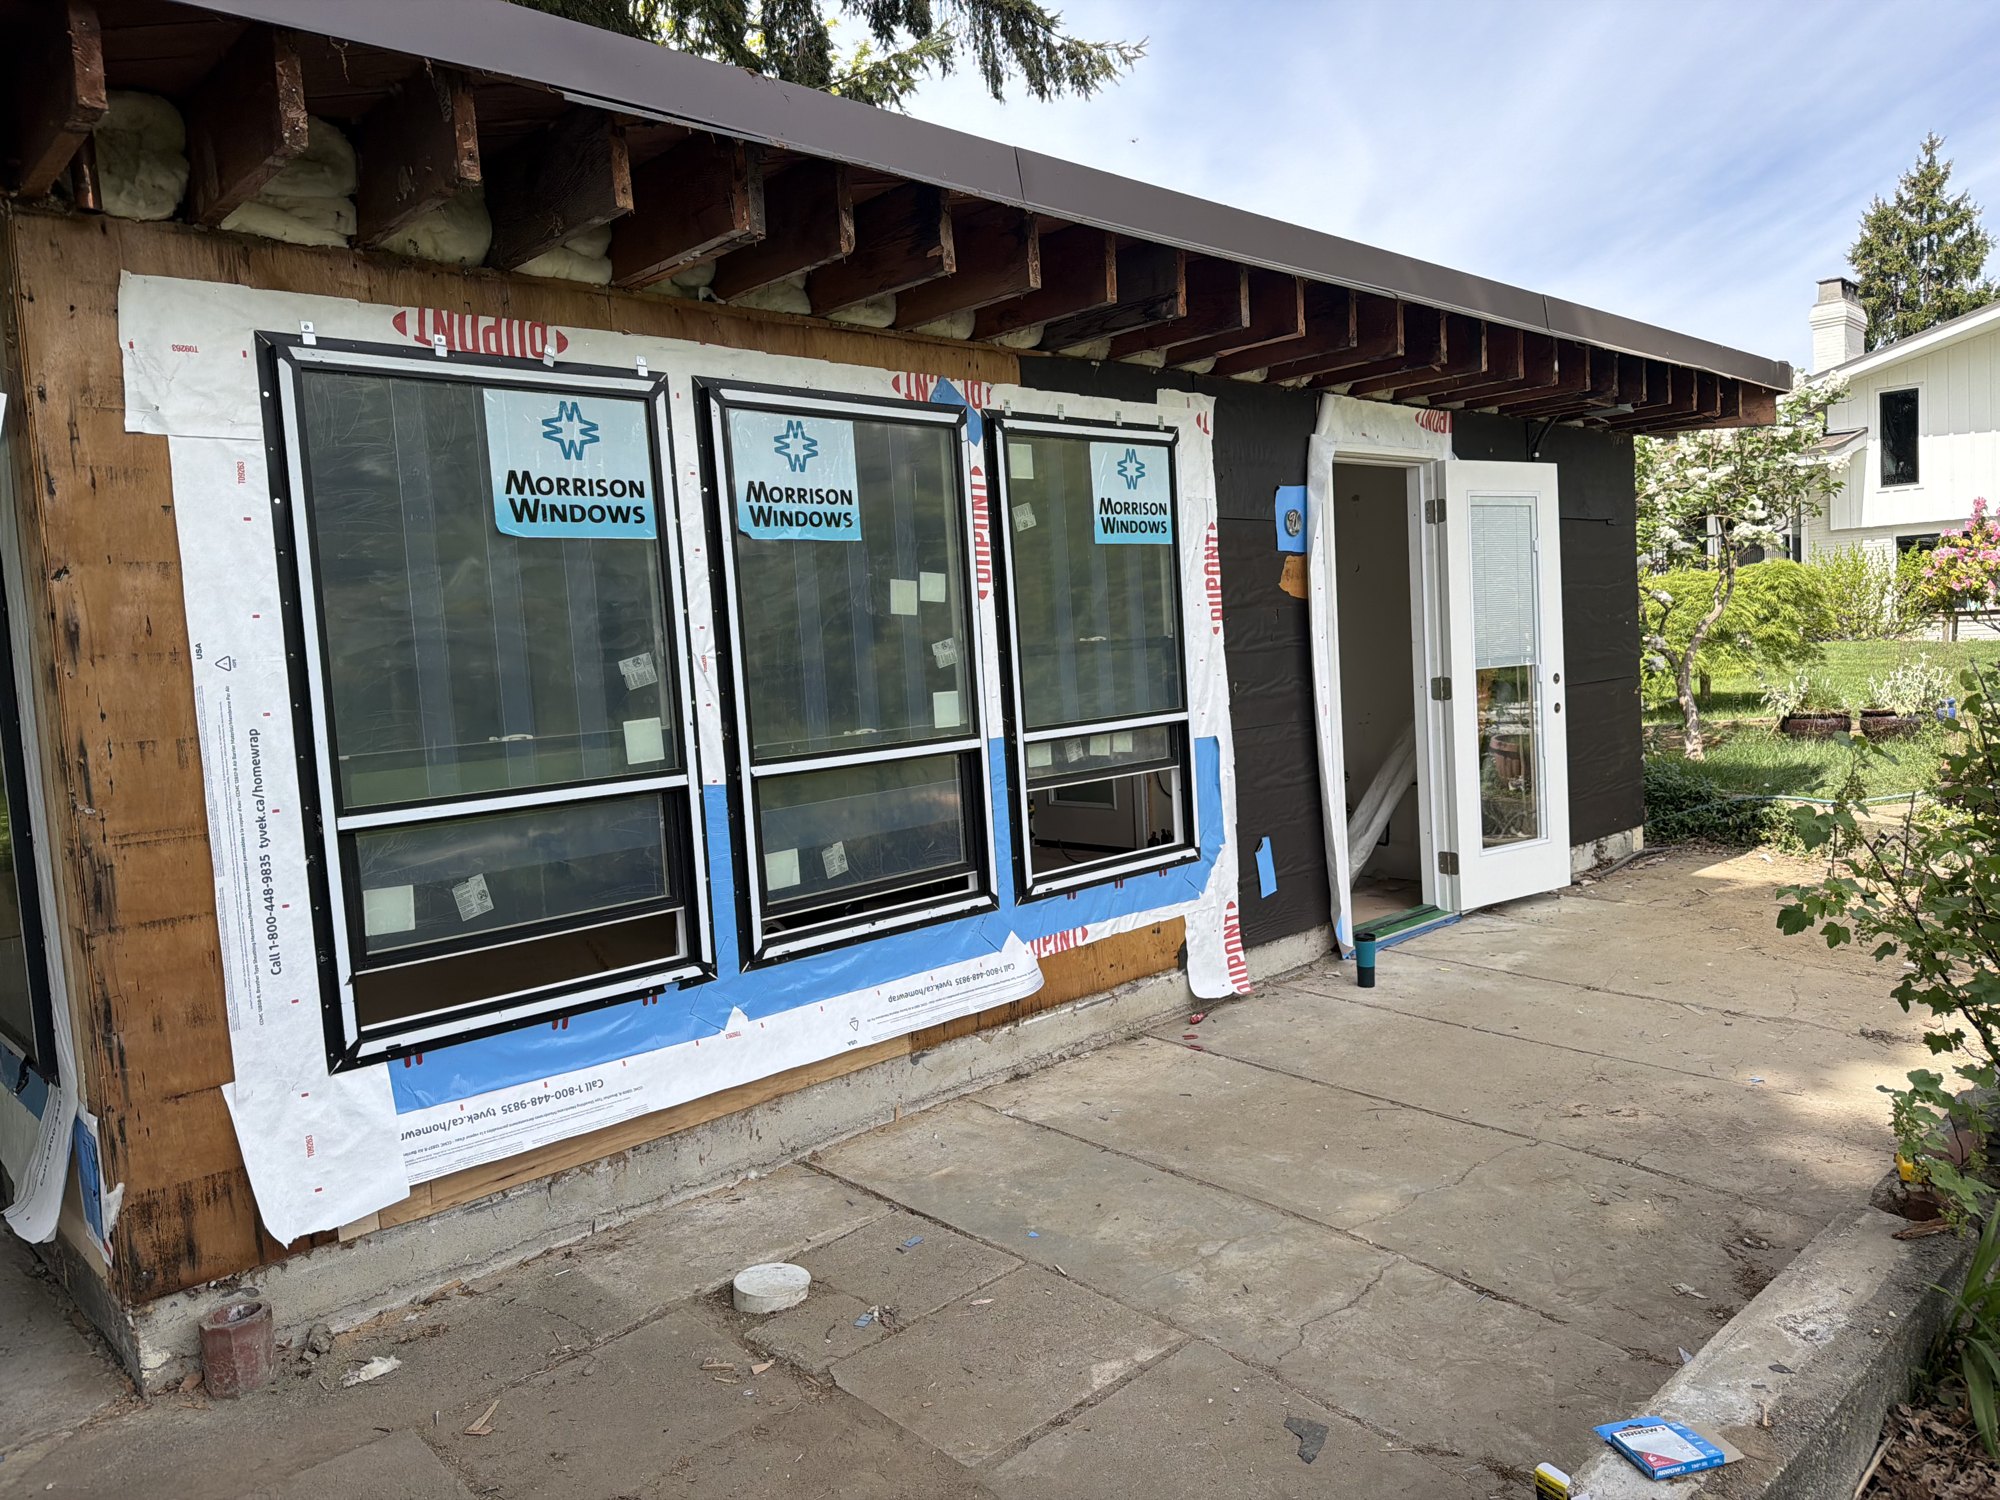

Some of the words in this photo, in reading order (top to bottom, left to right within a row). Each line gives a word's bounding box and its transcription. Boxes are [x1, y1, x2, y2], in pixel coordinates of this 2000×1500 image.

[415, 307, 547, 358] DUPONT
[172, 344, 198, 353] T09263
[237, 462, 245, 483] T09263
[506, 470, 645, 498] MORRISON
[746, 480, 853, 505] MORRISON
[508, 498, 646, 524] WINDOWS
[748, 505, 854, 528] WINDOWS
[1099, 497, 1167, 516] MORRISON
[1101, 516, 1167, 534] WINDOWS
[1204, 534, 1222, 621] DUPONT
[249, 728, 271, 848] tyvek.ca/homewrap
[259, 854, 279, 950] 1-800-448-9835
[269, 952, 282, 975] Call
[1003, 963, 1015, 972] Call
[955, 966, 1003, 986] 1-800-448-9835
[888, 979, 952, 1003] tyvek.ca/homewrap
[585, 1079, 604, 1092] Call
[501, 1085, 583, 1114] 1-800-448-9835
[306, 1135, 314, 1157] T09263
[1620, 1428, 1658, 1438] ARROW
[1657, 1467, 1680, 1476] ARROW
